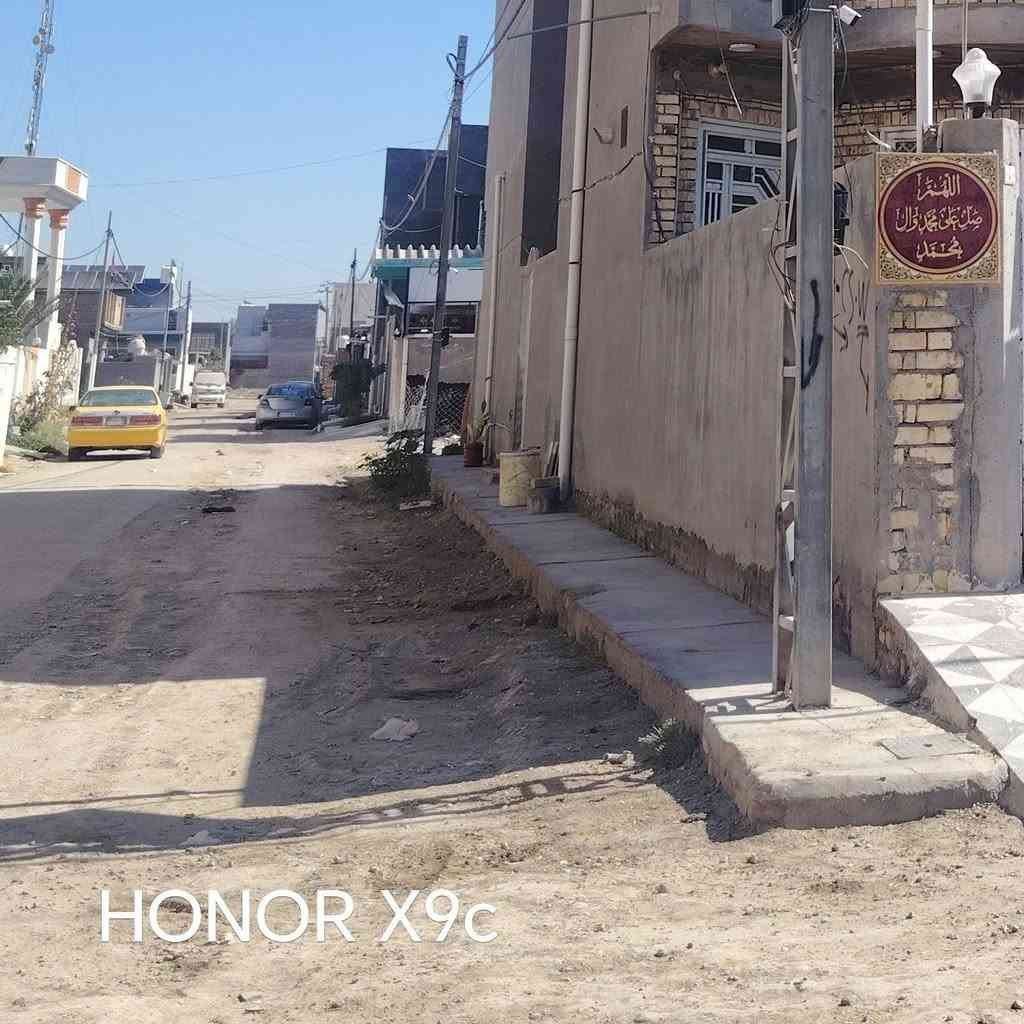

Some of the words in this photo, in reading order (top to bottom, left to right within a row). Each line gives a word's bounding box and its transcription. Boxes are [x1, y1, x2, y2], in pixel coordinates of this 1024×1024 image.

[917, 173, 960, 200] اللهم
[919, 208, 939, 235] محمد
[939, 206, 960, 231] على
[916, 236, 963, 262] محمد
